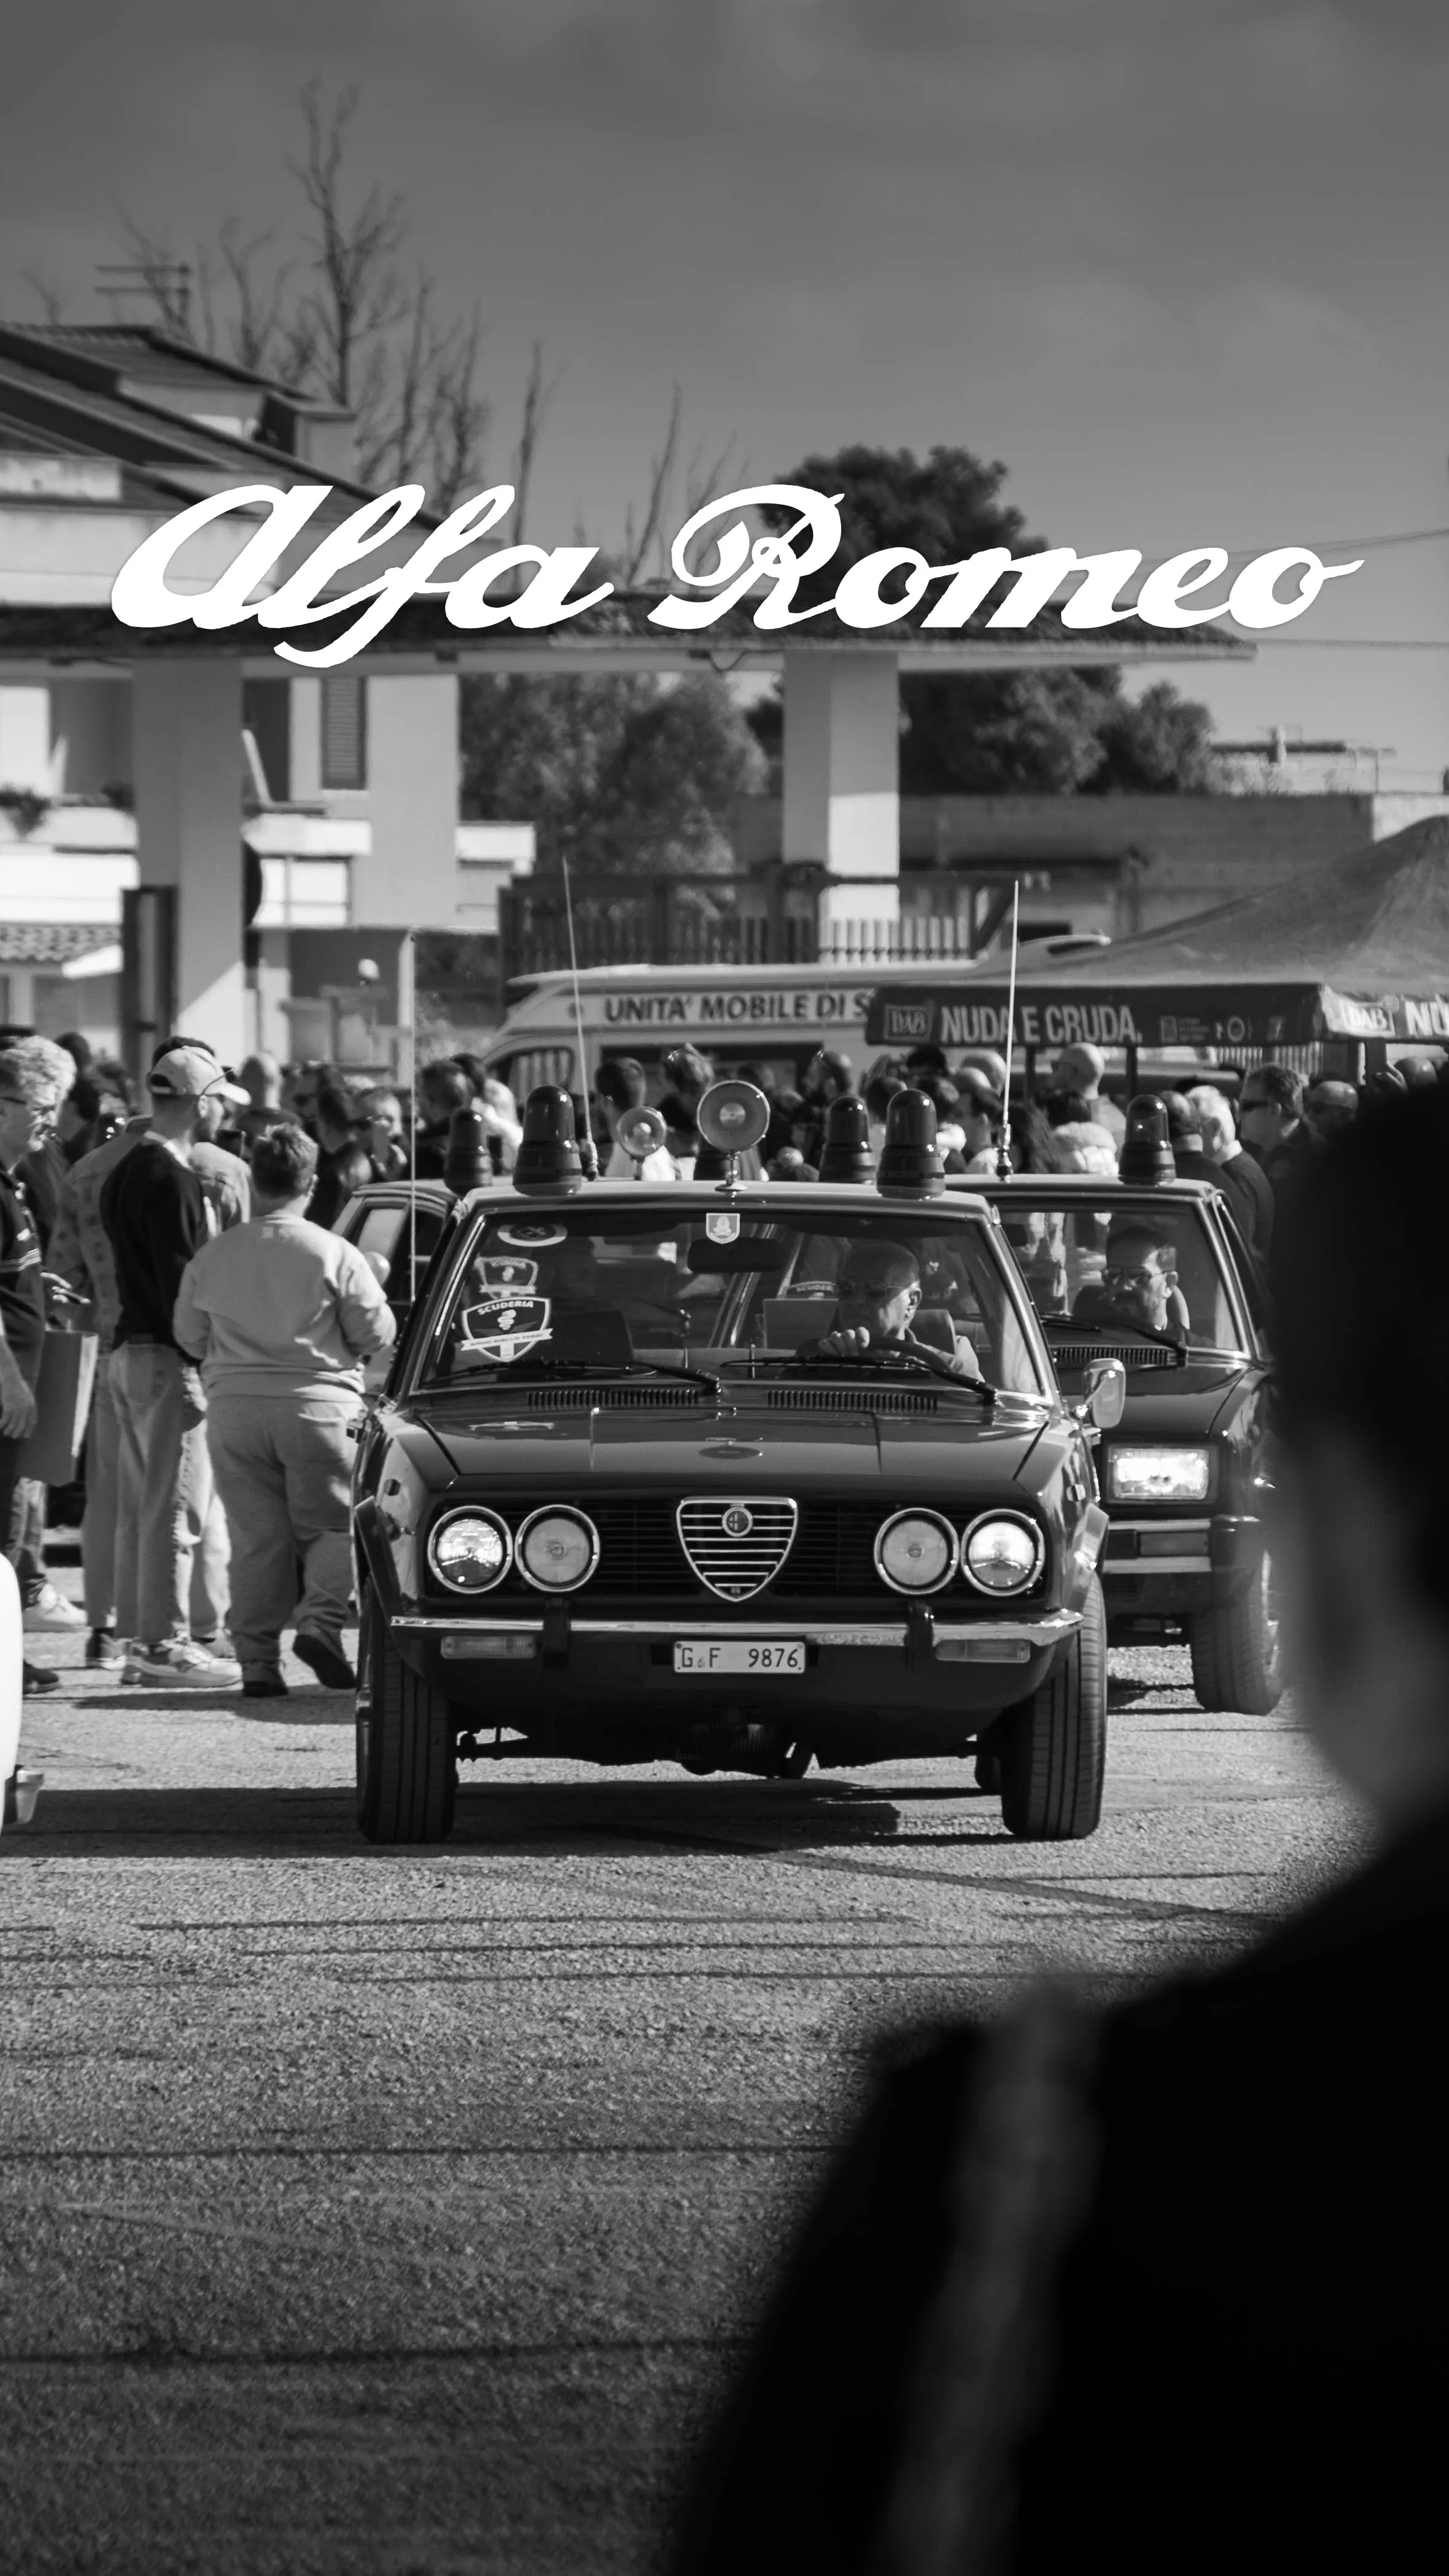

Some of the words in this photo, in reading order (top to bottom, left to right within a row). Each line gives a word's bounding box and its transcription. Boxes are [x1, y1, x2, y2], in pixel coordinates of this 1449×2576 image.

[605, 995, 694, 1021] UNITA'
[699, 994, 808, 1020] MOBILE
[816, 993, 845, 1018] DI
[941, 1005, 1017, 1043] NUDA
[1021, 1005, 1040, 1043] E
[1045, 1005, 1143, 1043] CRUDA.
[478, 1301, 534, 1315] SCUDERIA
[748, 1648, 798, 1668] 9876
